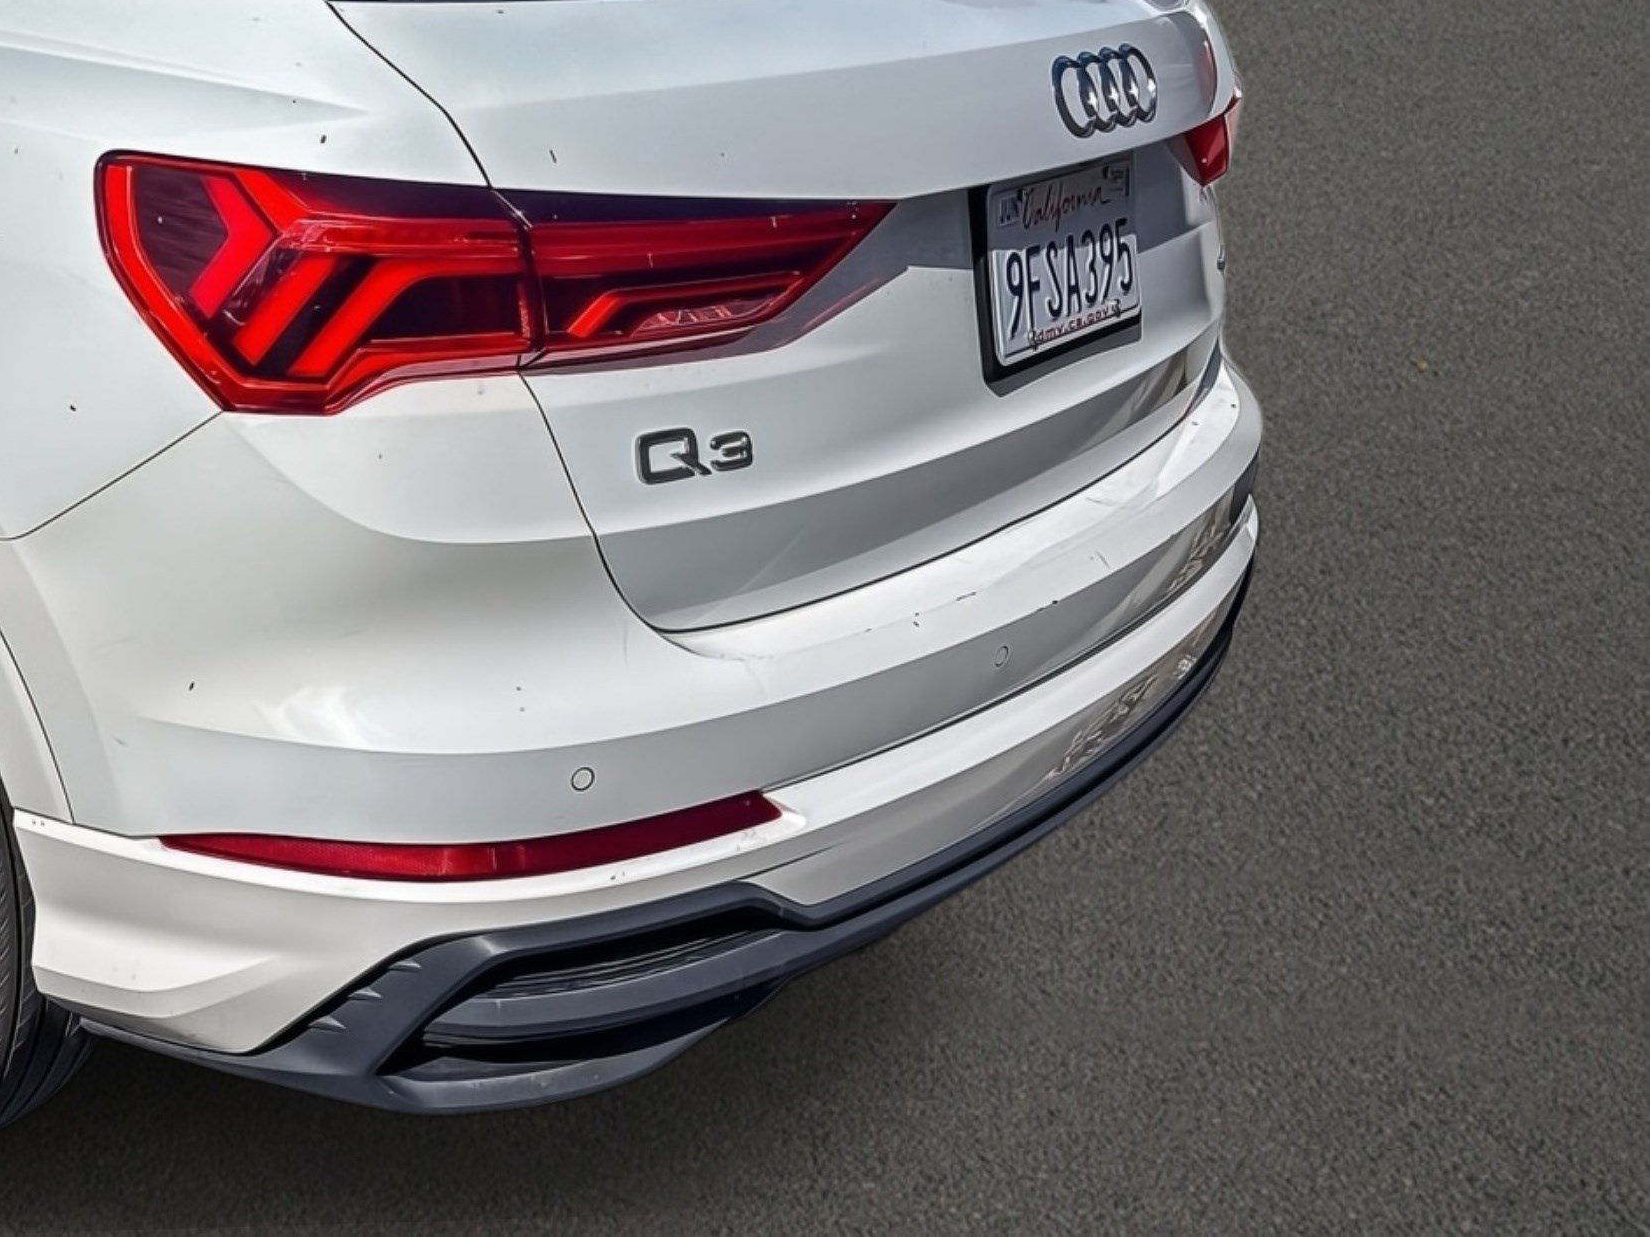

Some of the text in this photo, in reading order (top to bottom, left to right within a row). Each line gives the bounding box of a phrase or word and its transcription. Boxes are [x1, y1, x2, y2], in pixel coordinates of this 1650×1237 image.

[1021, 181, 1111, 233] California
[1005, 217, 1133, 341] 9FSA395
[634, 426, 753, 486] Q3
